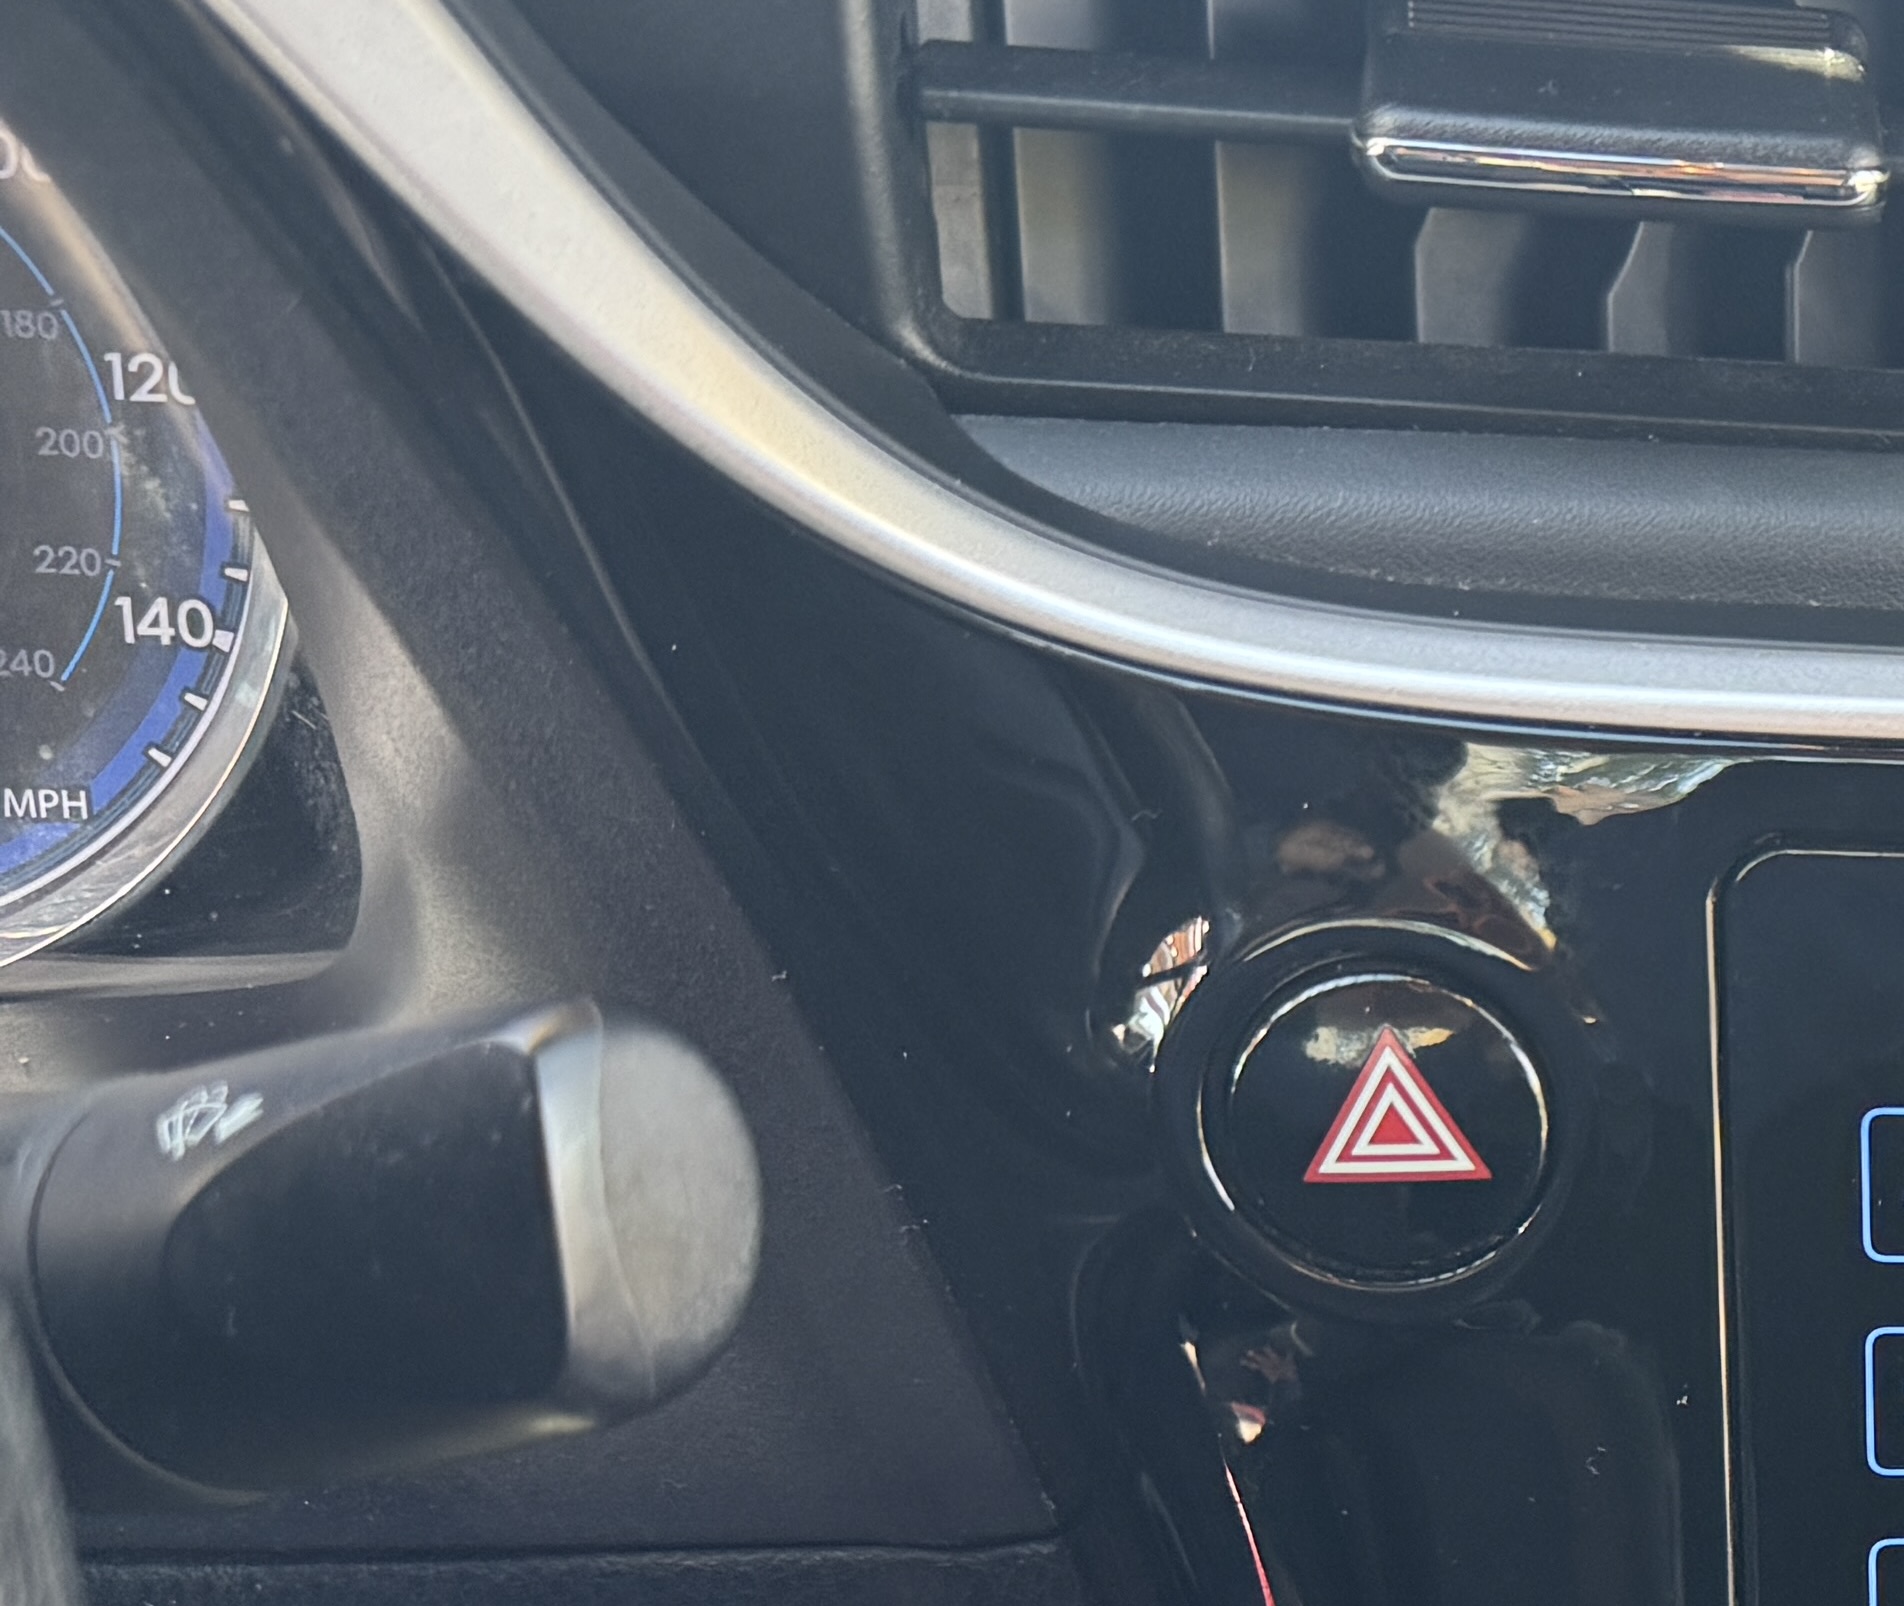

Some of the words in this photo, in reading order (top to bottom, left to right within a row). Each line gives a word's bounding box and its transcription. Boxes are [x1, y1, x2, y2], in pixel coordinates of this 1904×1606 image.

[36, 427, 104, 459] 200
[33, 545, 101, 576] 220
[114, 596, 214, 648] 140
[3, 787, 89, 820] MPH
